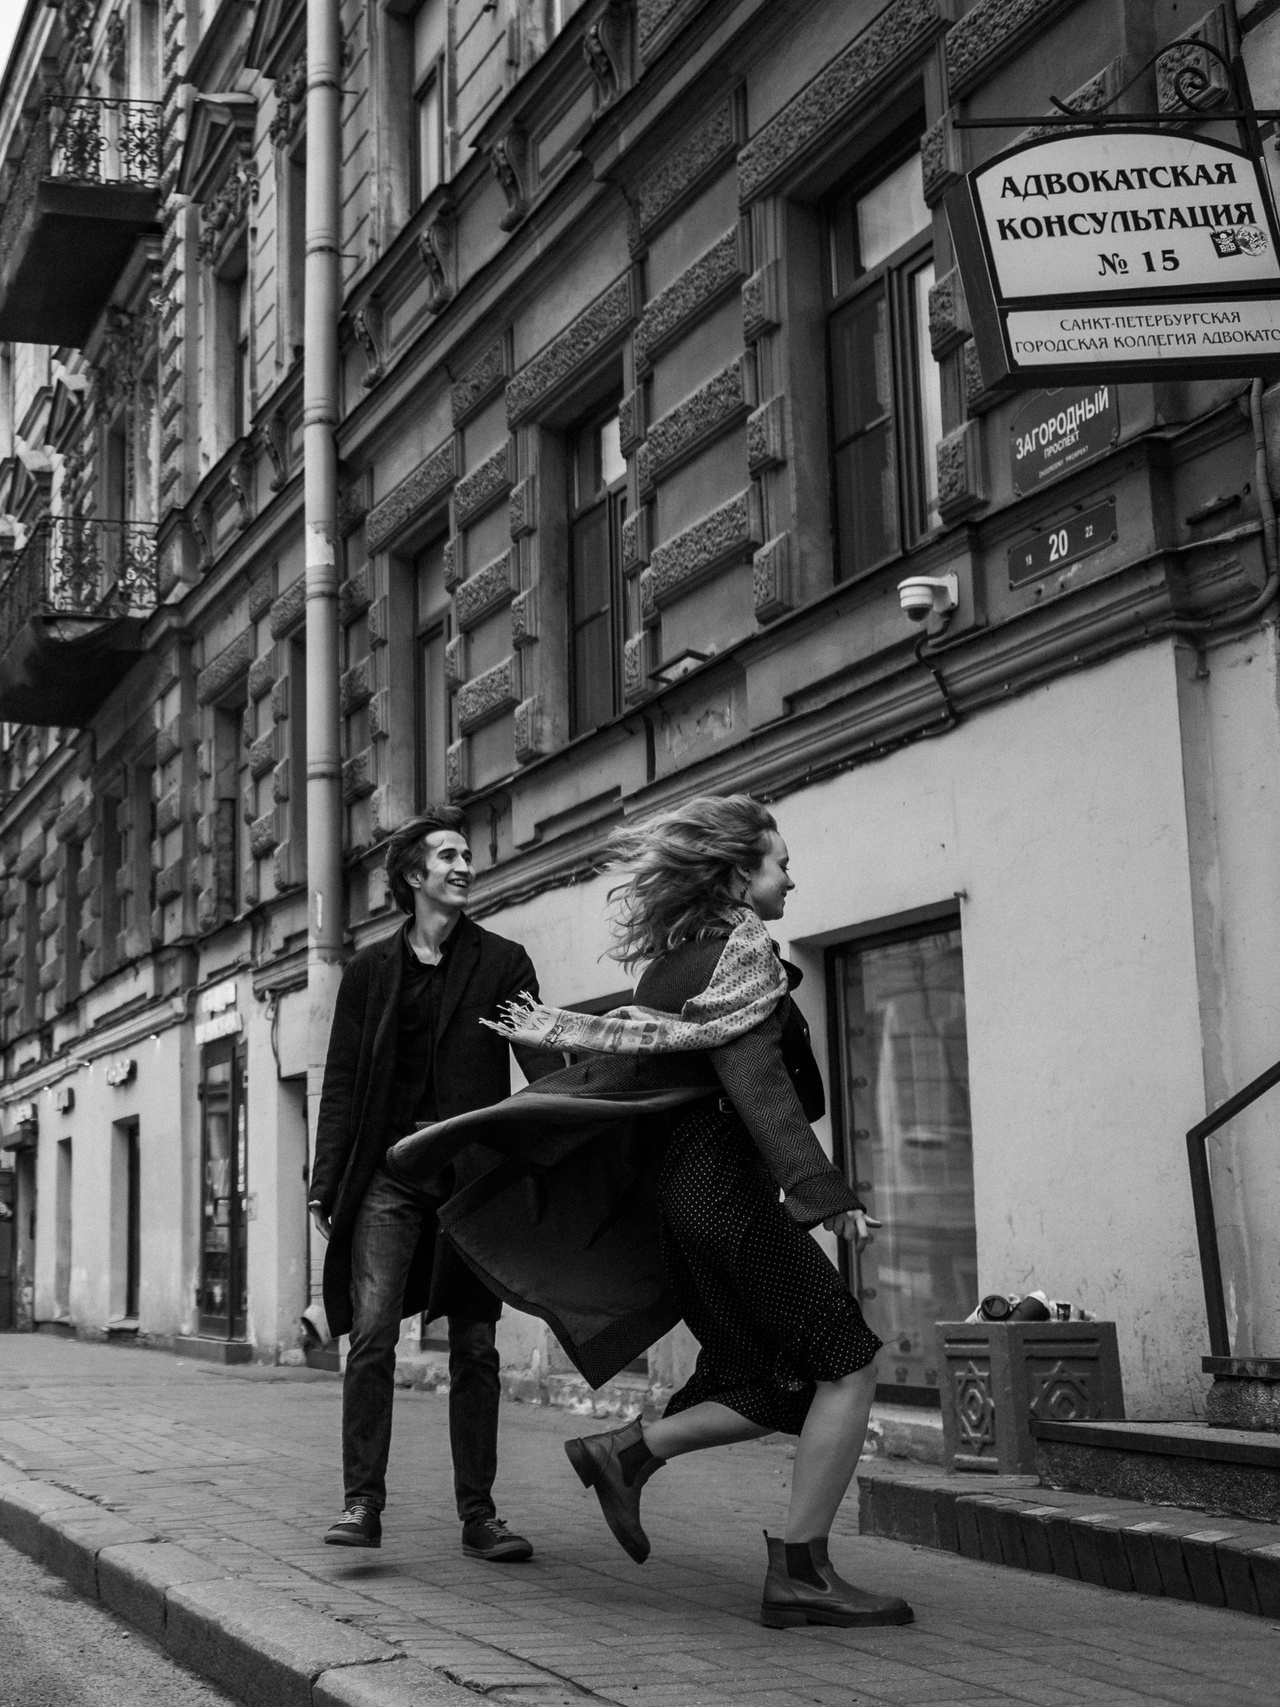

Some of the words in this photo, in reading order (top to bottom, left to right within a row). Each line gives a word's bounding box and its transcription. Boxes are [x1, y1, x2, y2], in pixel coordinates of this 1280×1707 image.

[1000, 162, 1238, 202] АДВОКАТСКАЯ
[996, 202, 1258, 241] КОНСУЛЬТАЦИЯ
[1097, 252, 1130, 277] №
[1141, 249, 1181, 274] 15
[1059, 311, 1242, 332] САНКТ-ПЕТЕРБУРГСКАЯ
[1015, 337, 1109, 354] ГОРОДСКАЯ
[1114, 333, 1198, 349] КОЛЛЕГИЯ
[1015, 386, 1110, 460] ЗАГОРОДНЫЙ
[1043, 431, 1080, 460] ПРОСПЕКТ
[1048, 529, 1069, 562] 20
[1085, 525, 1094, 539] 22
